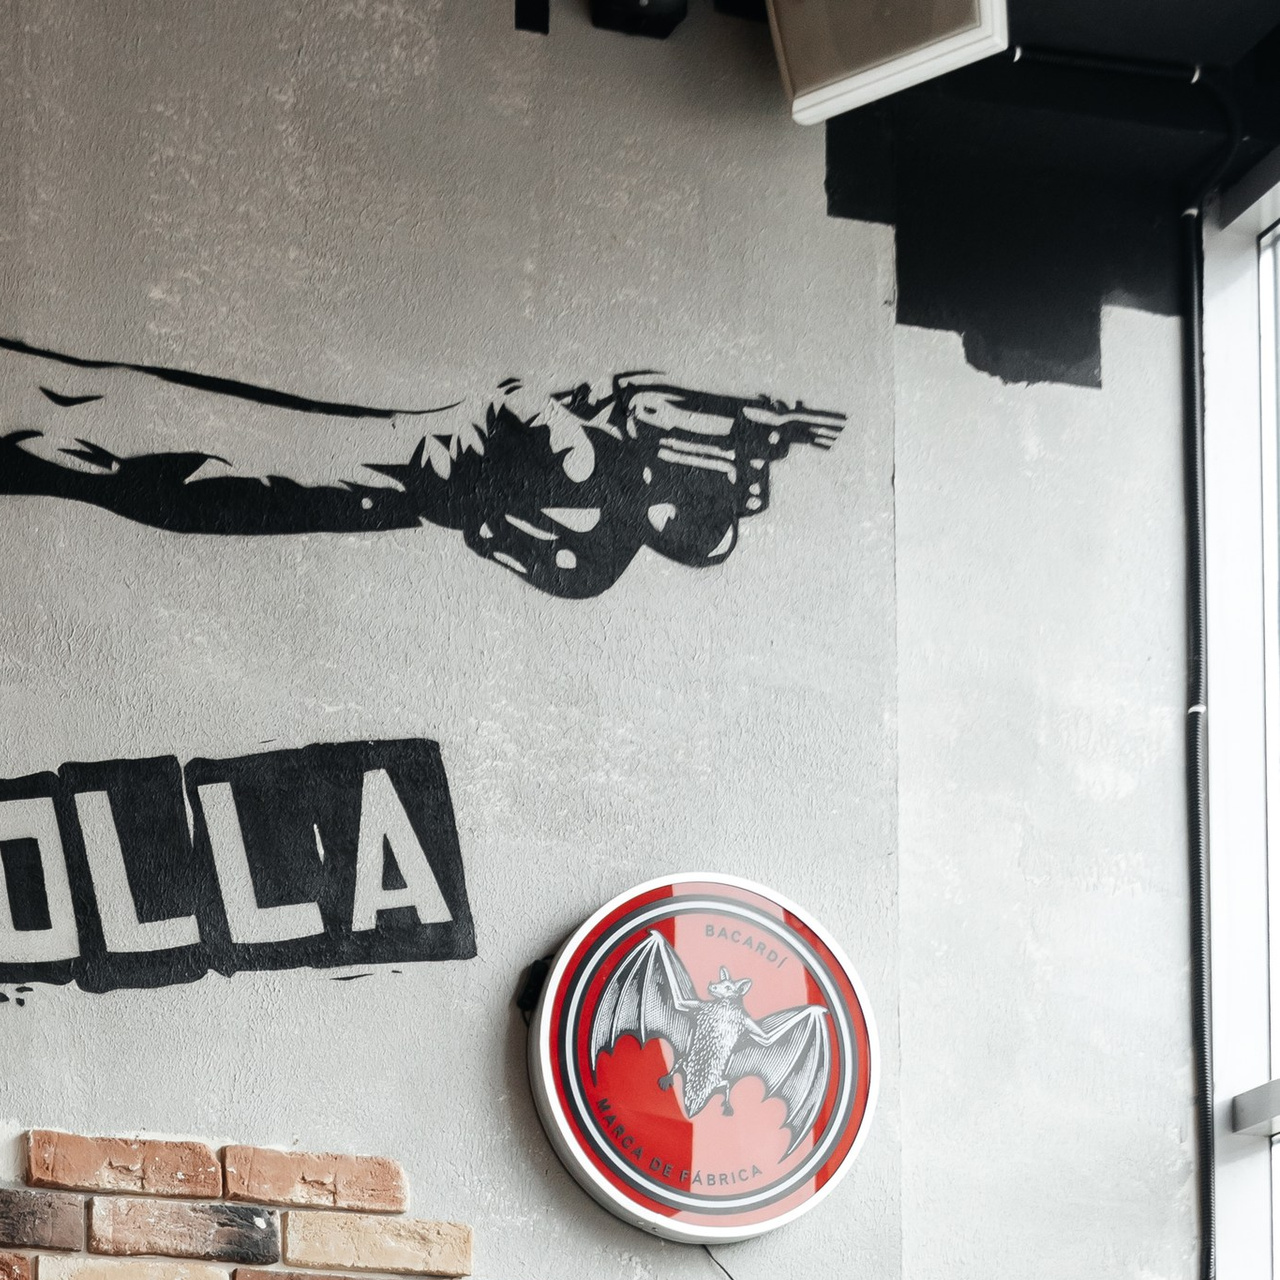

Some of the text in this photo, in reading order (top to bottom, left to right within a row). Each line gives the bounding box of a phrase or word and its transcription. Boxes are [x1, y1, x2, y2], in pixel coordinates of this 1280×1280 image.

[596, 1098, 763, 1187] MARCA DE FÁBRICA
